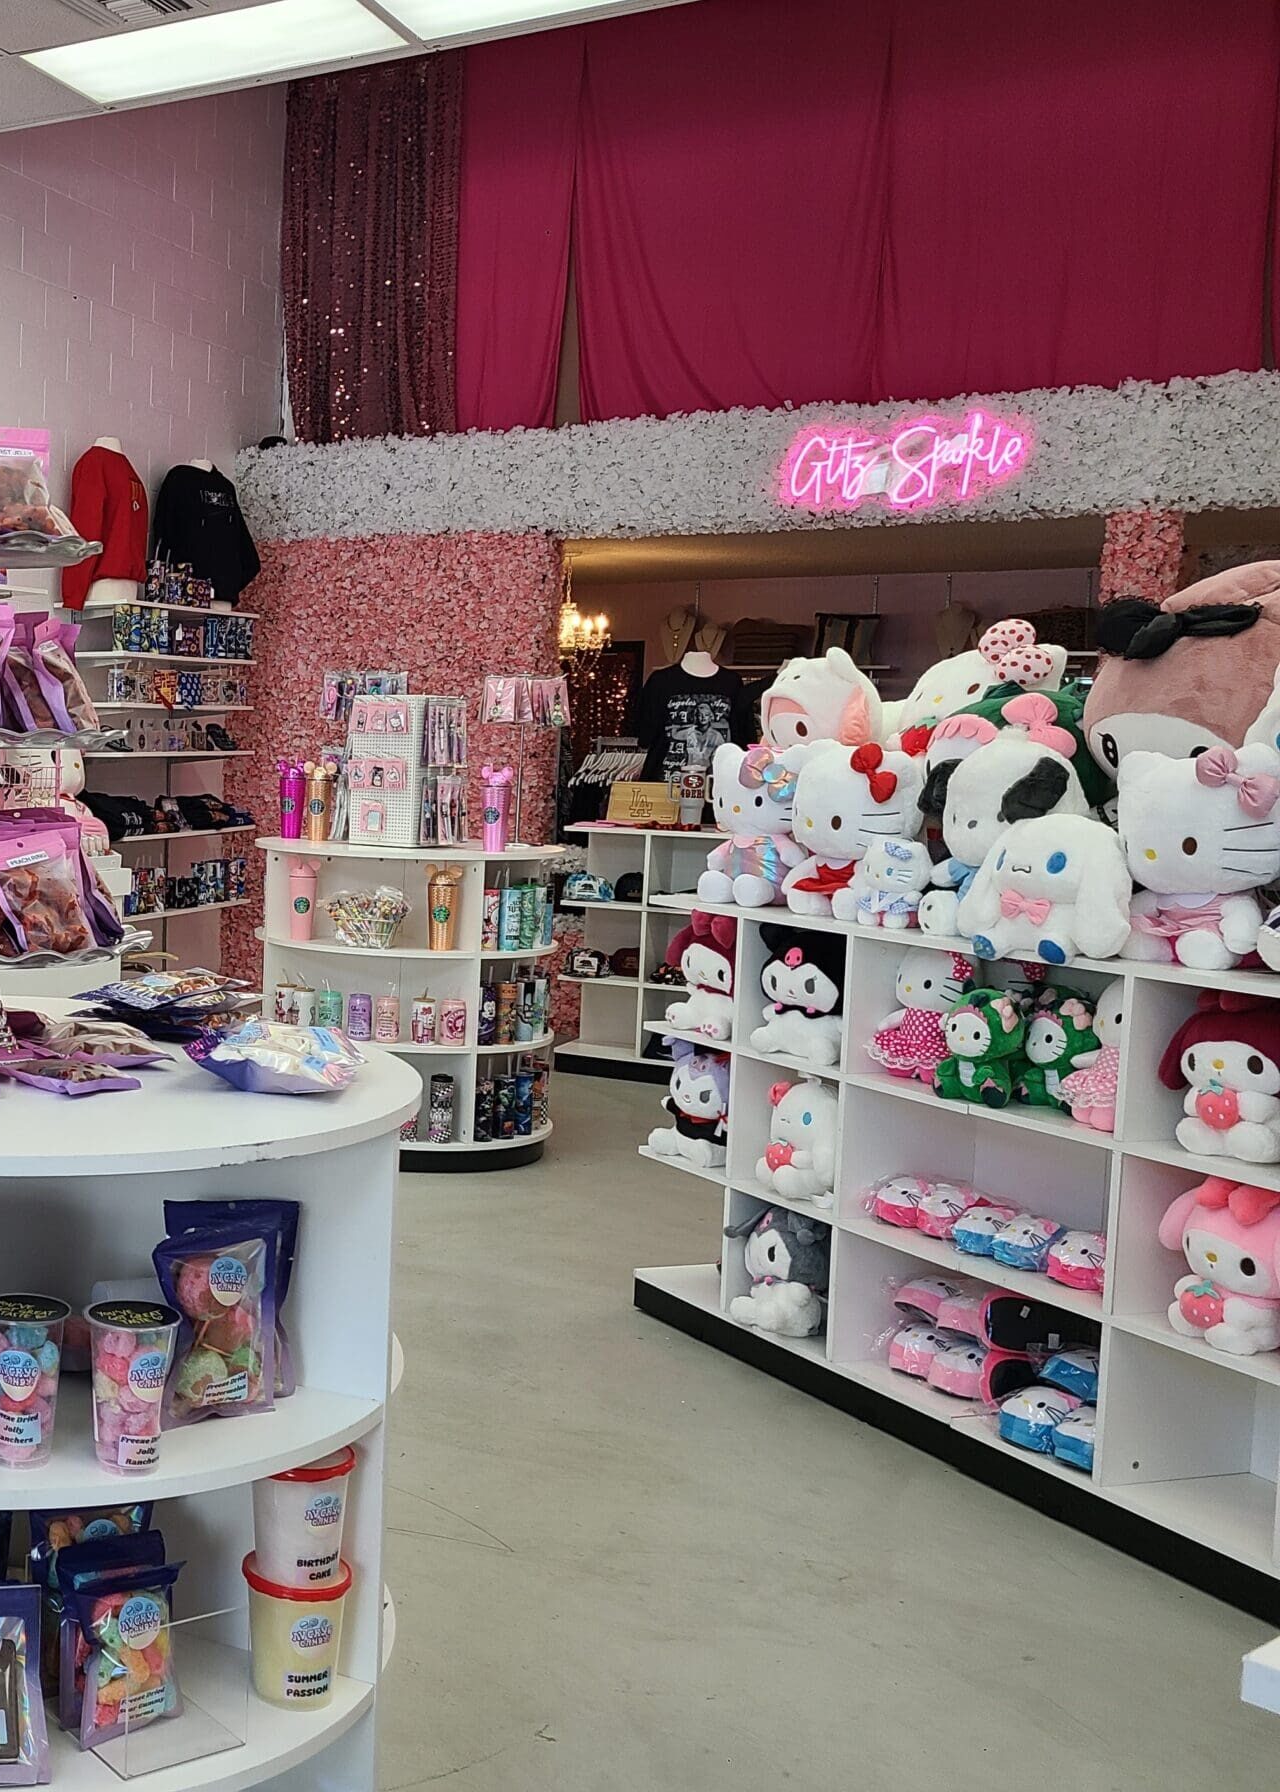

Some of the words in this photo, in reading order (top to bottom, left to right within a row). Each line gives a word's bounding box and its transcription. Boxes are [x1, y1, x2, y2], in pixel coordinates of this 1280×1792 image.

[791, 436, 880, 503] Glitz
[893, 413, 1021, 503] Sparkle
[680, 789, 705, 799] 49ER
[629, 788, 653, 817] LA
[8, 1365, 38, 1377] CRYO
[16, 1412, 40, 1424] Dried
[3, 1425, 24, 1436] Jolly
[121, 1435, 149, 1445] Freeze
[136, 1447, 156, 1457] Jolly
[125, 1456, 159, 1466] Ranche
[296, 1550, 339, 1568] BIRTHDAY
[309, 1568, 332, 1581] CAKE
[287, 1670, 328, 1683] SUMMER
[286, 1684, 328, 1699] PASSION
